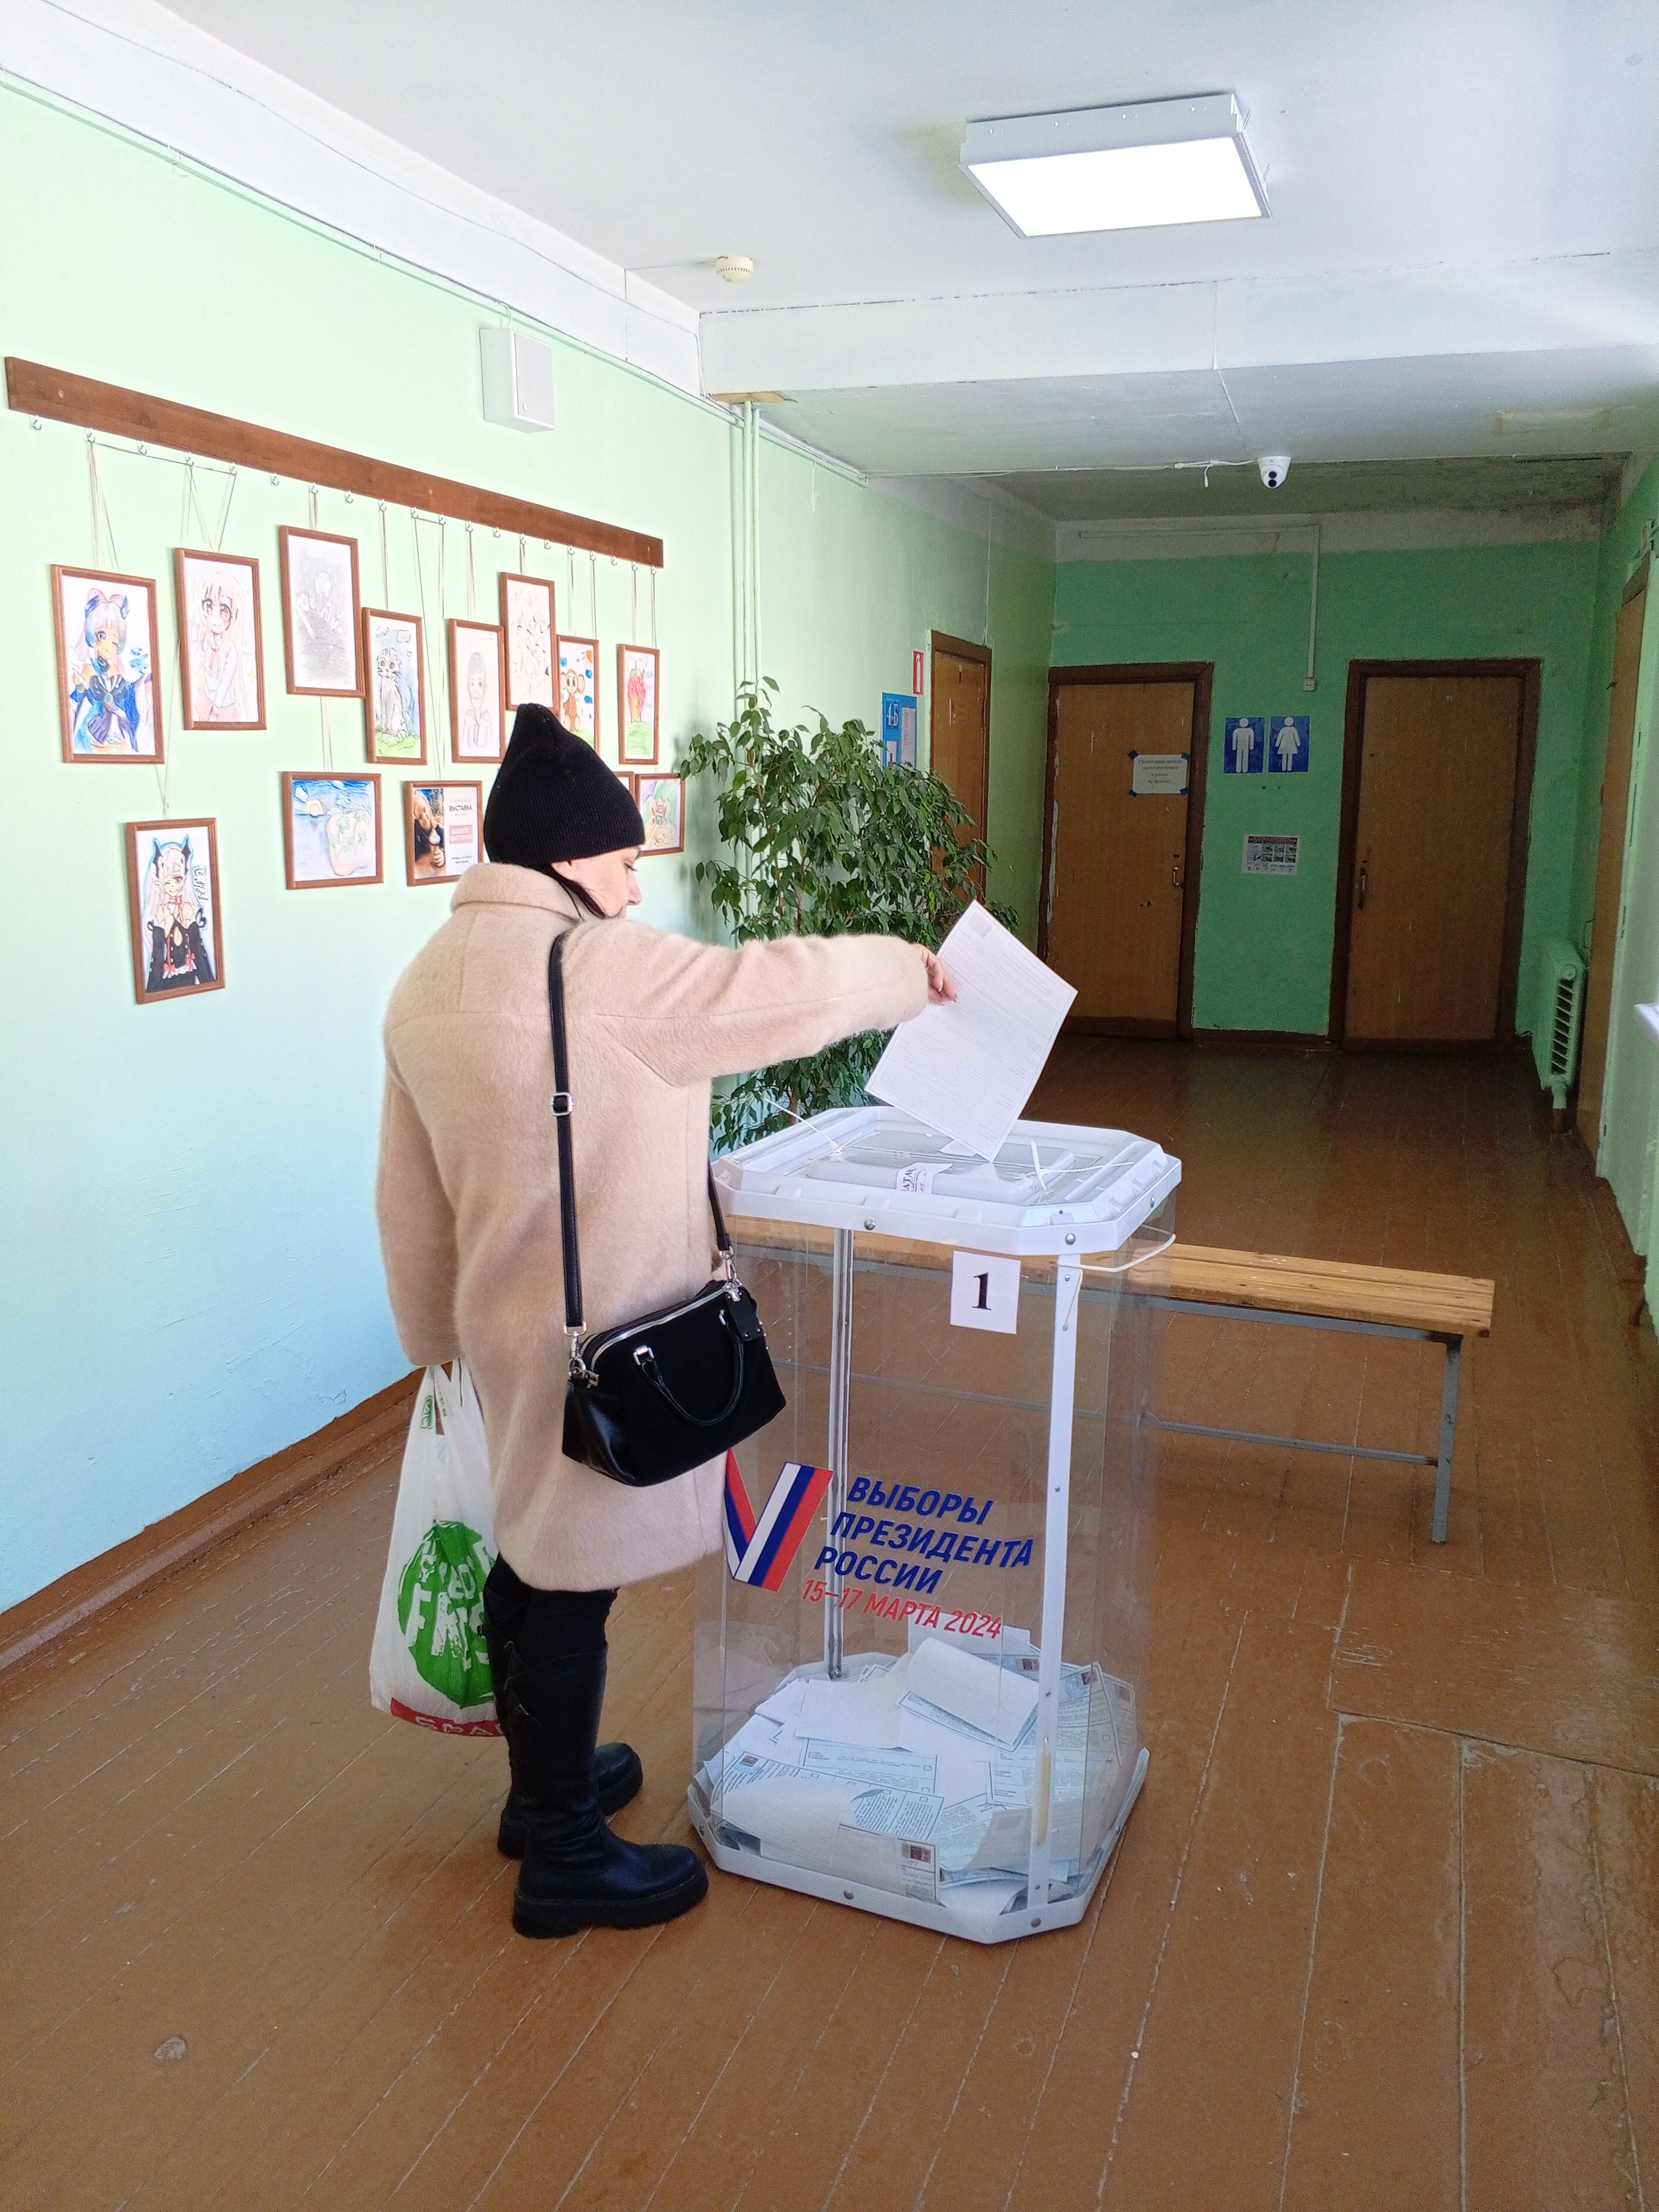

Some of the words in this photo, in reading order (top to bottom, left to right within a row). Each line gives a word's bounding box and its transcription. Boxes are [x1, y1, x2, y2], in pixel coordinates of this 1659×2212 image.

[972, 1272, 992, 1311] 1
[847, 1476, 993, 1525] ВЫБОРЫ
[831, 1511, 1033, 1569] ПРЕЗИДЕНТА
[814, 1546, 944, 1594] РОССИИ
[864, 1594, 941, 1629] МАРТА
[944, 1609, 1002, 1639] 2024
